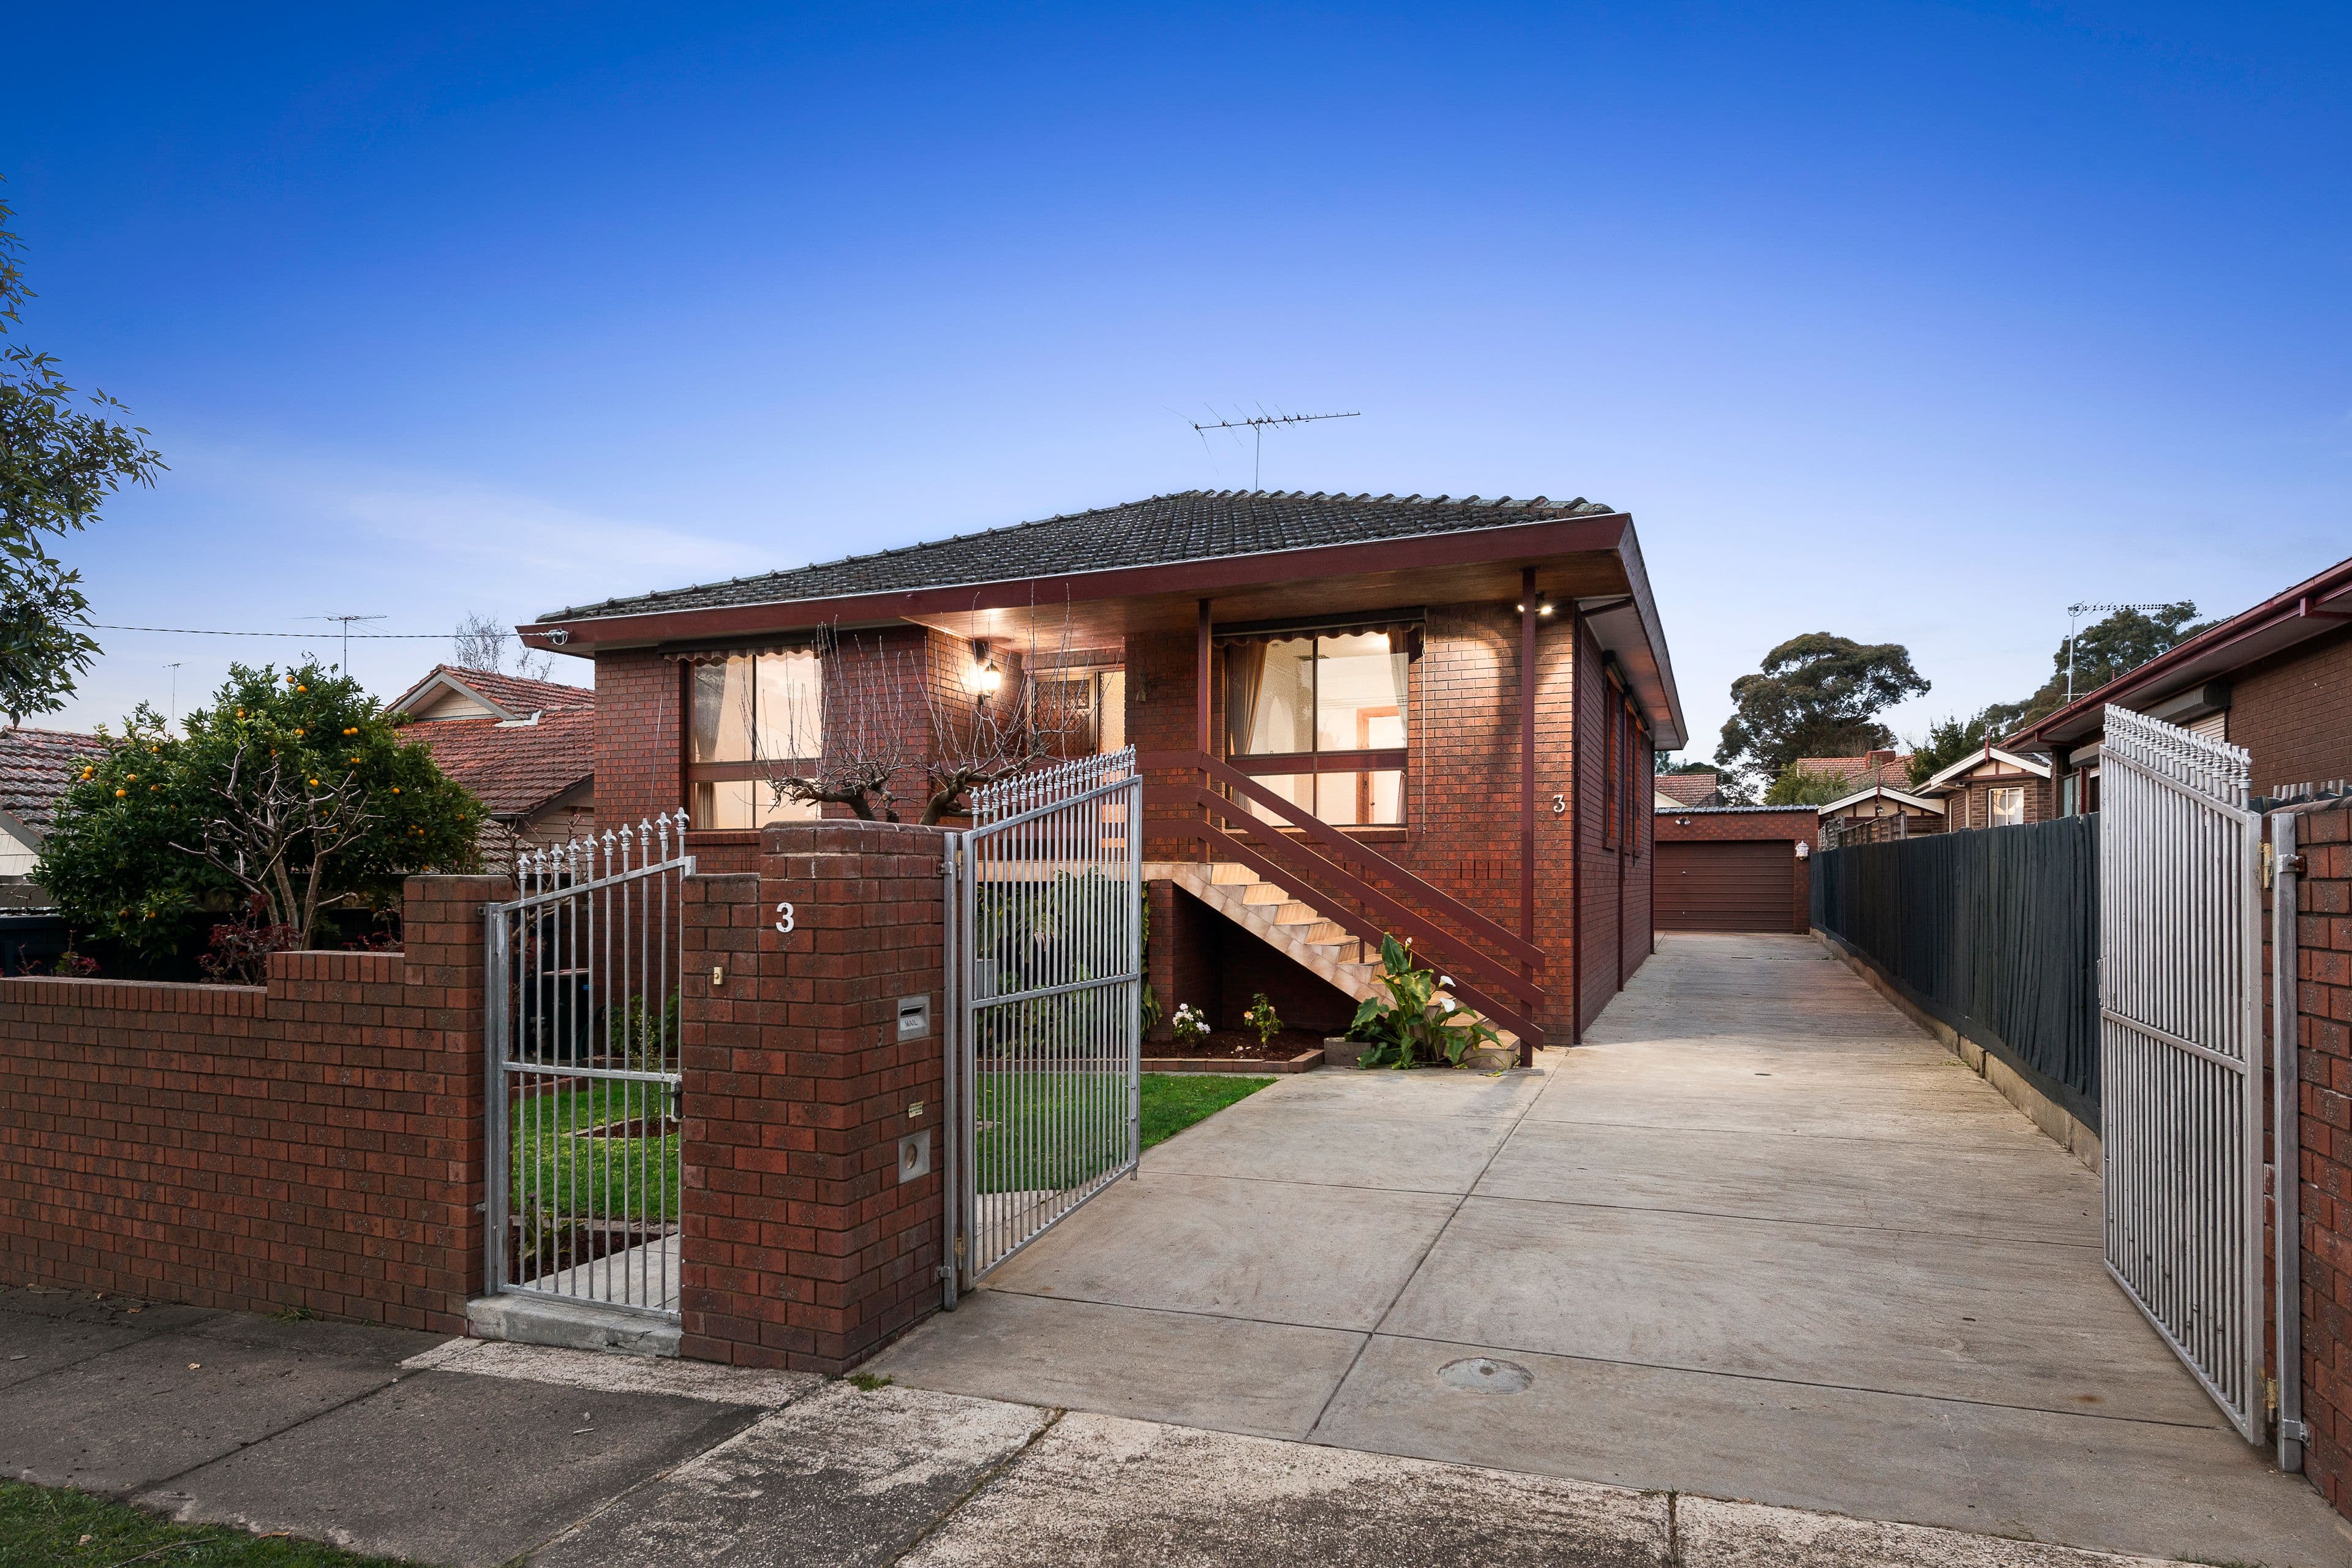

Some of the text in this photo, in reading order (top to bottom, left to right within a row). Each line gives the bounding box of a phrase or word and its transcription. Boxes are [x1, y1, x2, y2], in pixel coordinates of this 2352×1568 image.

[1553, 794, 1565, 813] 3
[775, 902, 794, 933] 3
[904, 1019, 918, 1027] MAIL
